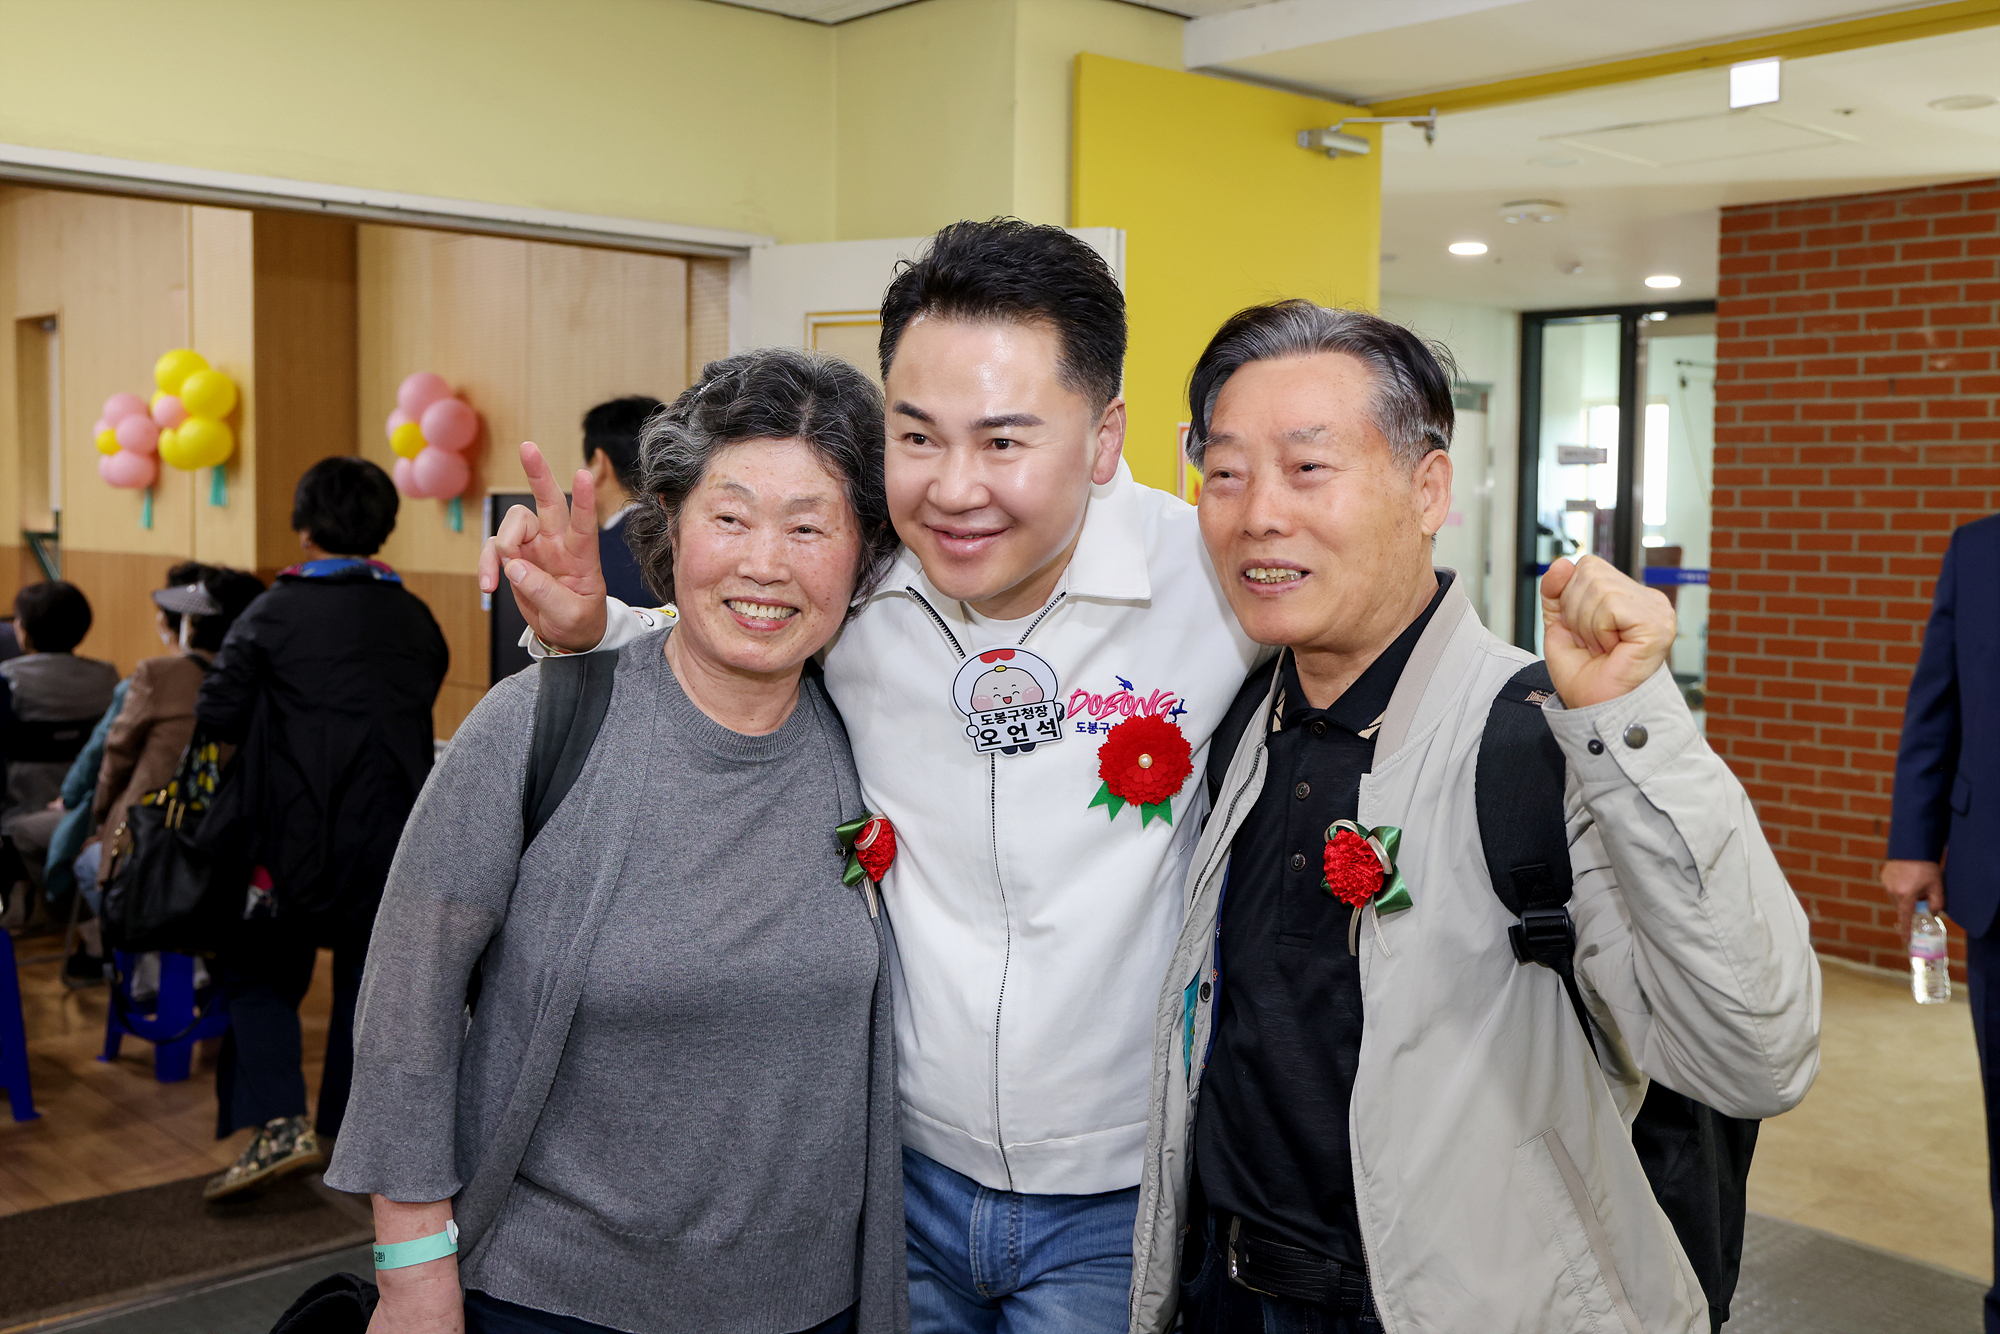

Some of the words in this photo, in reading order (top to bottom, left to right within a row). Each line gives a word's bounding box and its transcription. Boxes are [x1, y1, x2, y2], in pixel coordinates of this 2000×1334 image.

[980, 704, 1048, 726] 도봉구청장
[1067, 688, 1178, 721] DOBONG
[1075, 721, 1110, 735] 도봉구
